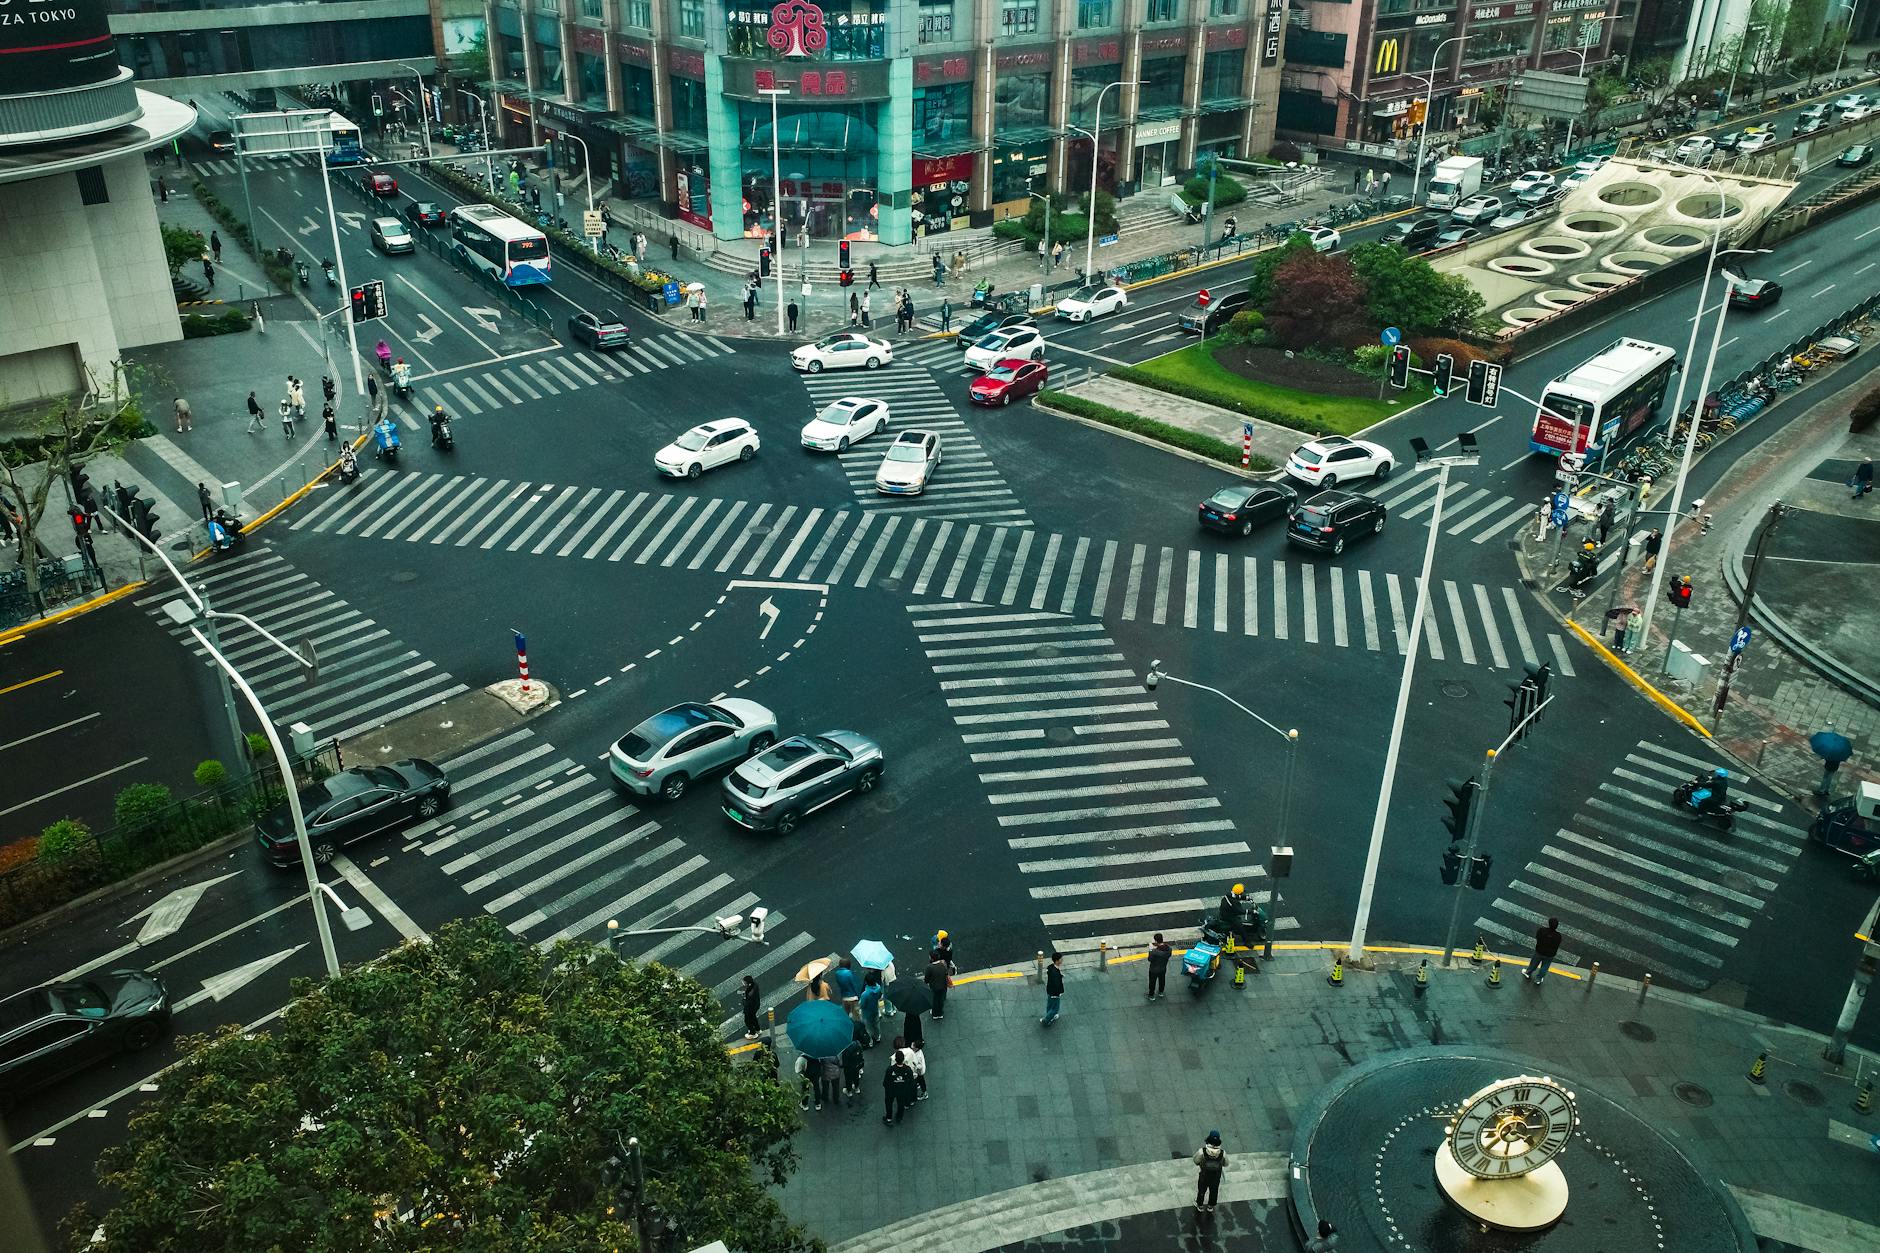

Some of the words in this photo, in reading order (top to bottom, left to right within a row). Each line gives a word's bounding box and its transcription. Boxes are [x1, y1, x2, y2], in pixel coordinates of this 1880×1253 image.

[1, 14, 24, 25] ZA
[29, 8, 76, 23] TOKYO
[1415, 13, 1447, 24] McDonald's
[754, 70, 847, 96] 第一食品
[1159, 125, 1180, 135] COFFEE
[1484, 367, 1499, 404] 右转信号灯
[1512, 1089, 1531, 1101] XII
[1487, 1096, 1503, 1110] XI
[1550, 1105, 1566, 1116] II
[1468, 1113, 1484, 1123] X
[1551, 1123, 1568, 1133] III
[1459, 1130, 1475, 1140] IX
[1459, 1143, 1478, 1162] VIII
[1524, 1156, 1535, 1166] V
[1498, 1161, 1510, 1173] VI
